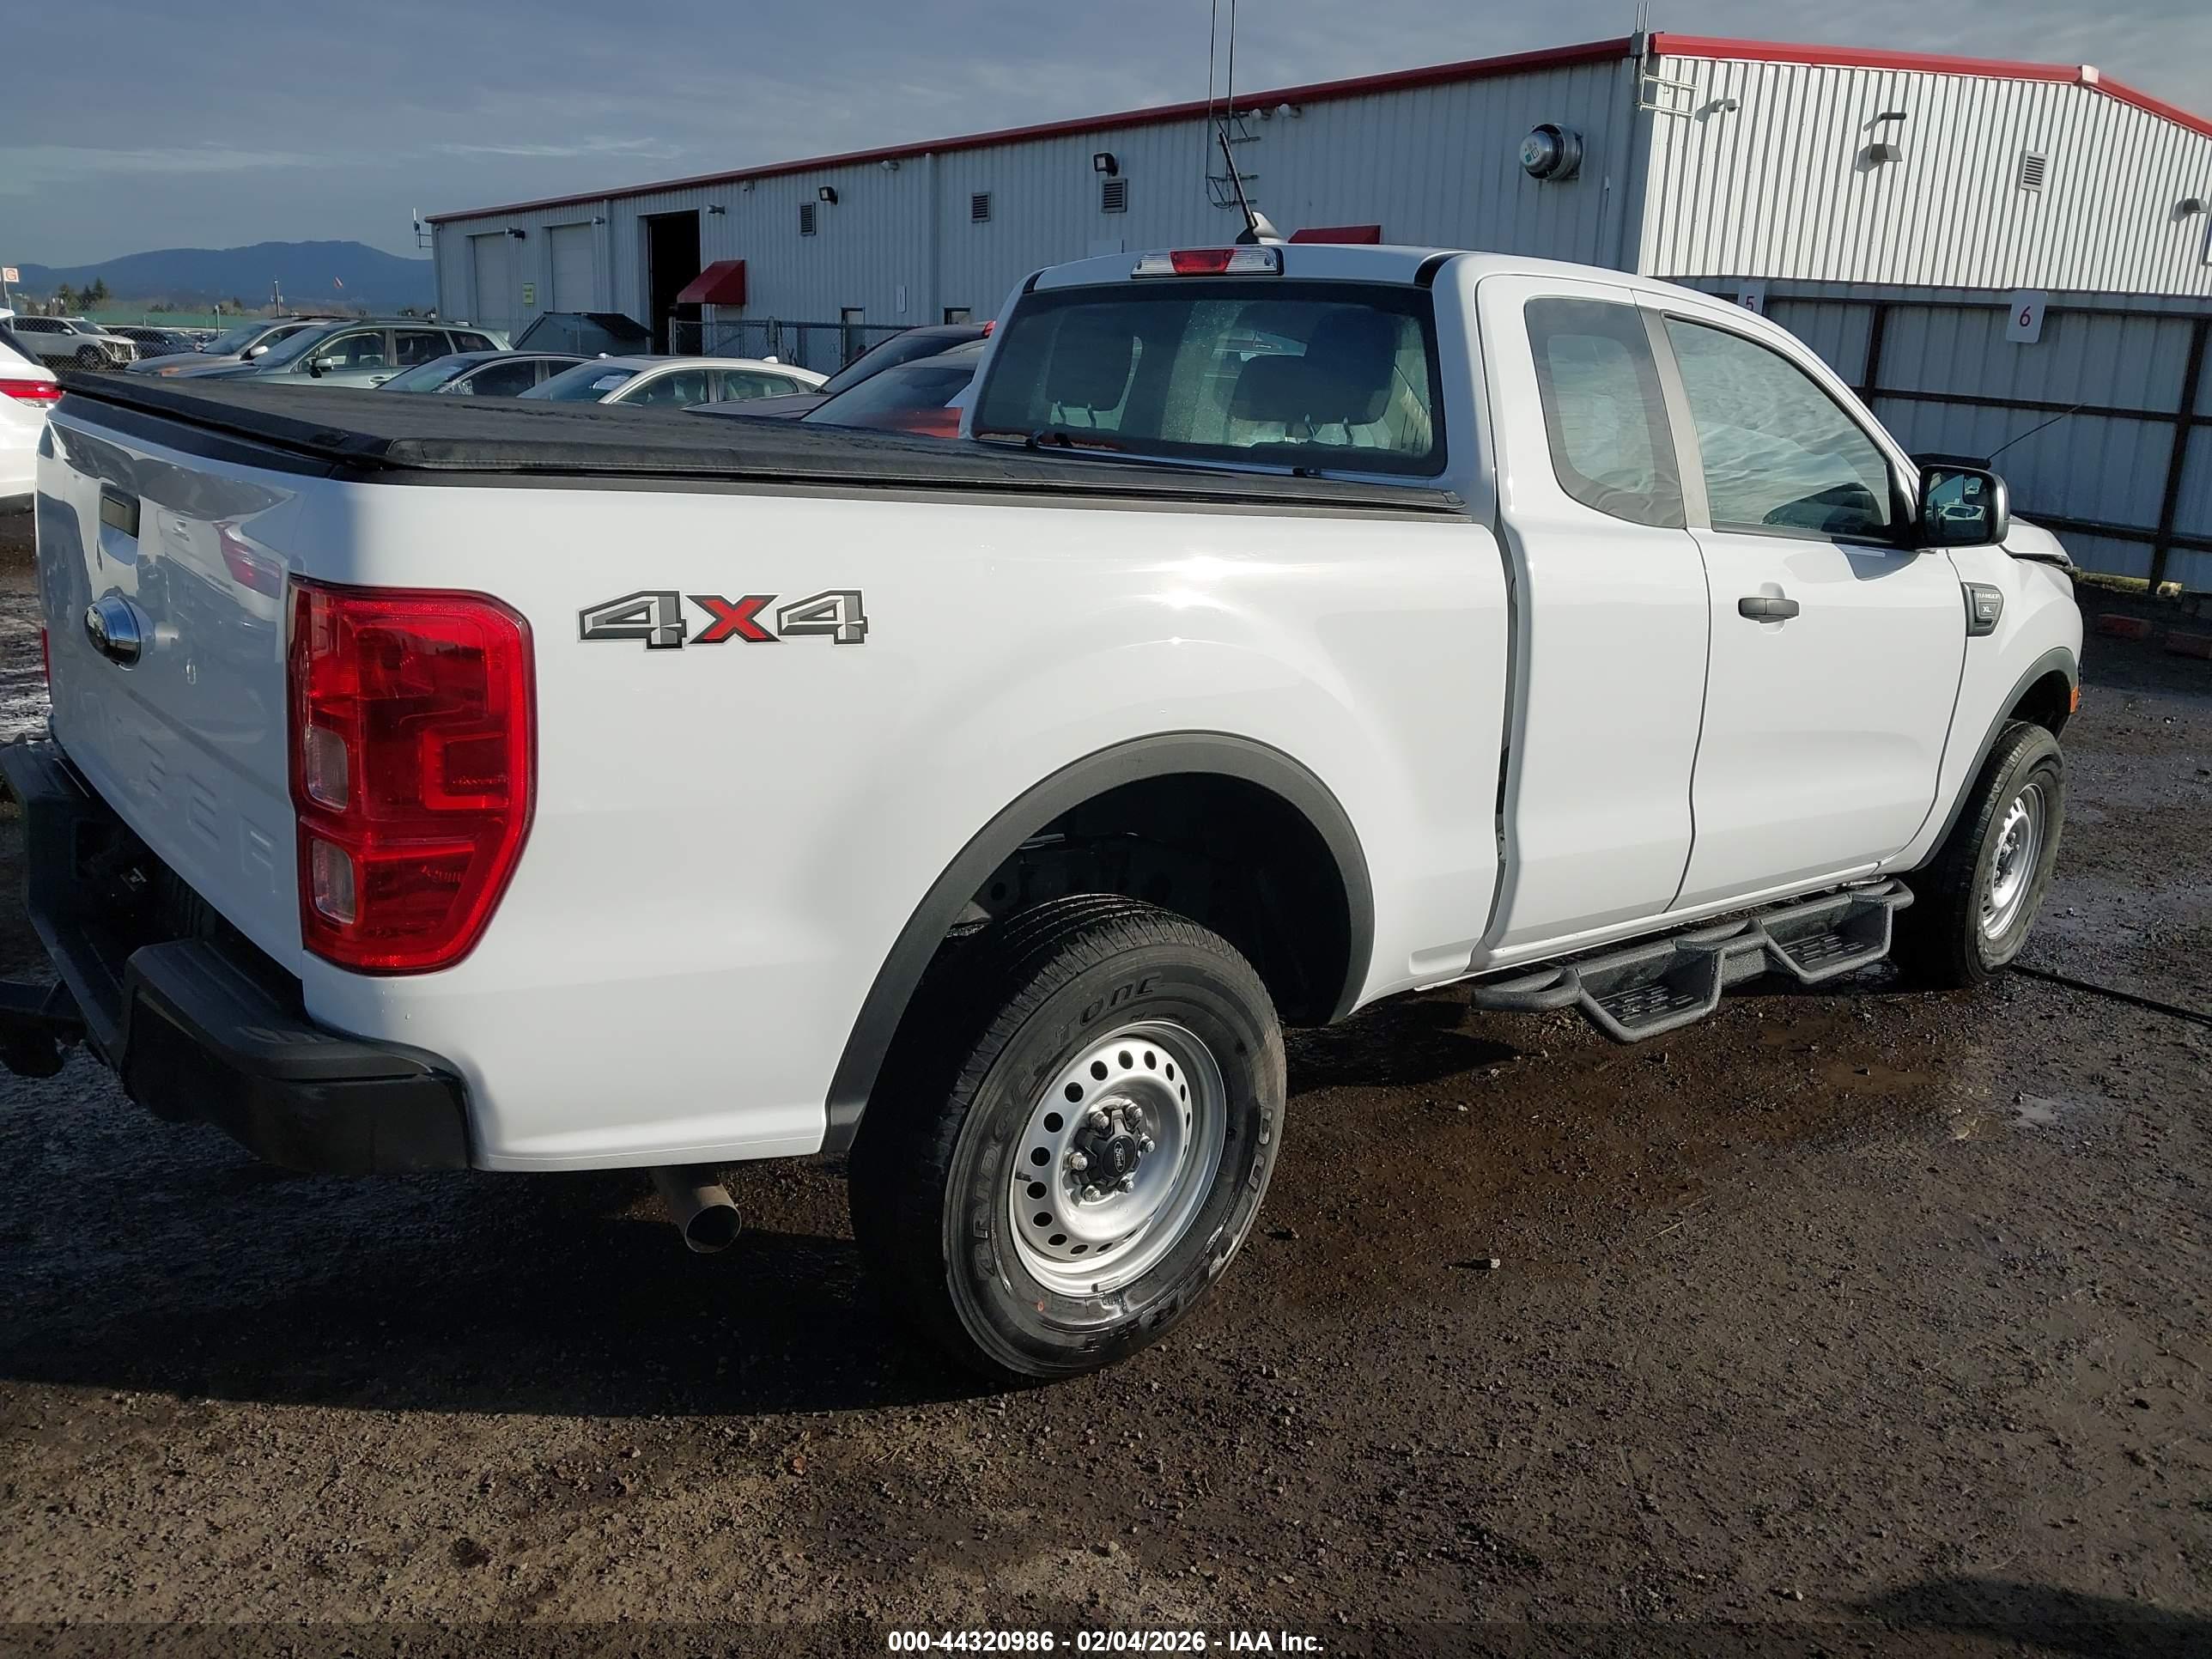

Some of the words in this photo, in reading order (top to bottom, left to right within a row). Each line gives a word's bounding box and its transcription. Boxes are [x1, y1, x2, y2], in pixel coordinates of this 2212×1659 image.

[5, 269, 17, 281] G
[1745, 295, 1755, 311] 5
[2020, 306, 2031, 327] 6
[1115, 1146, 1124, 1169] Ford
